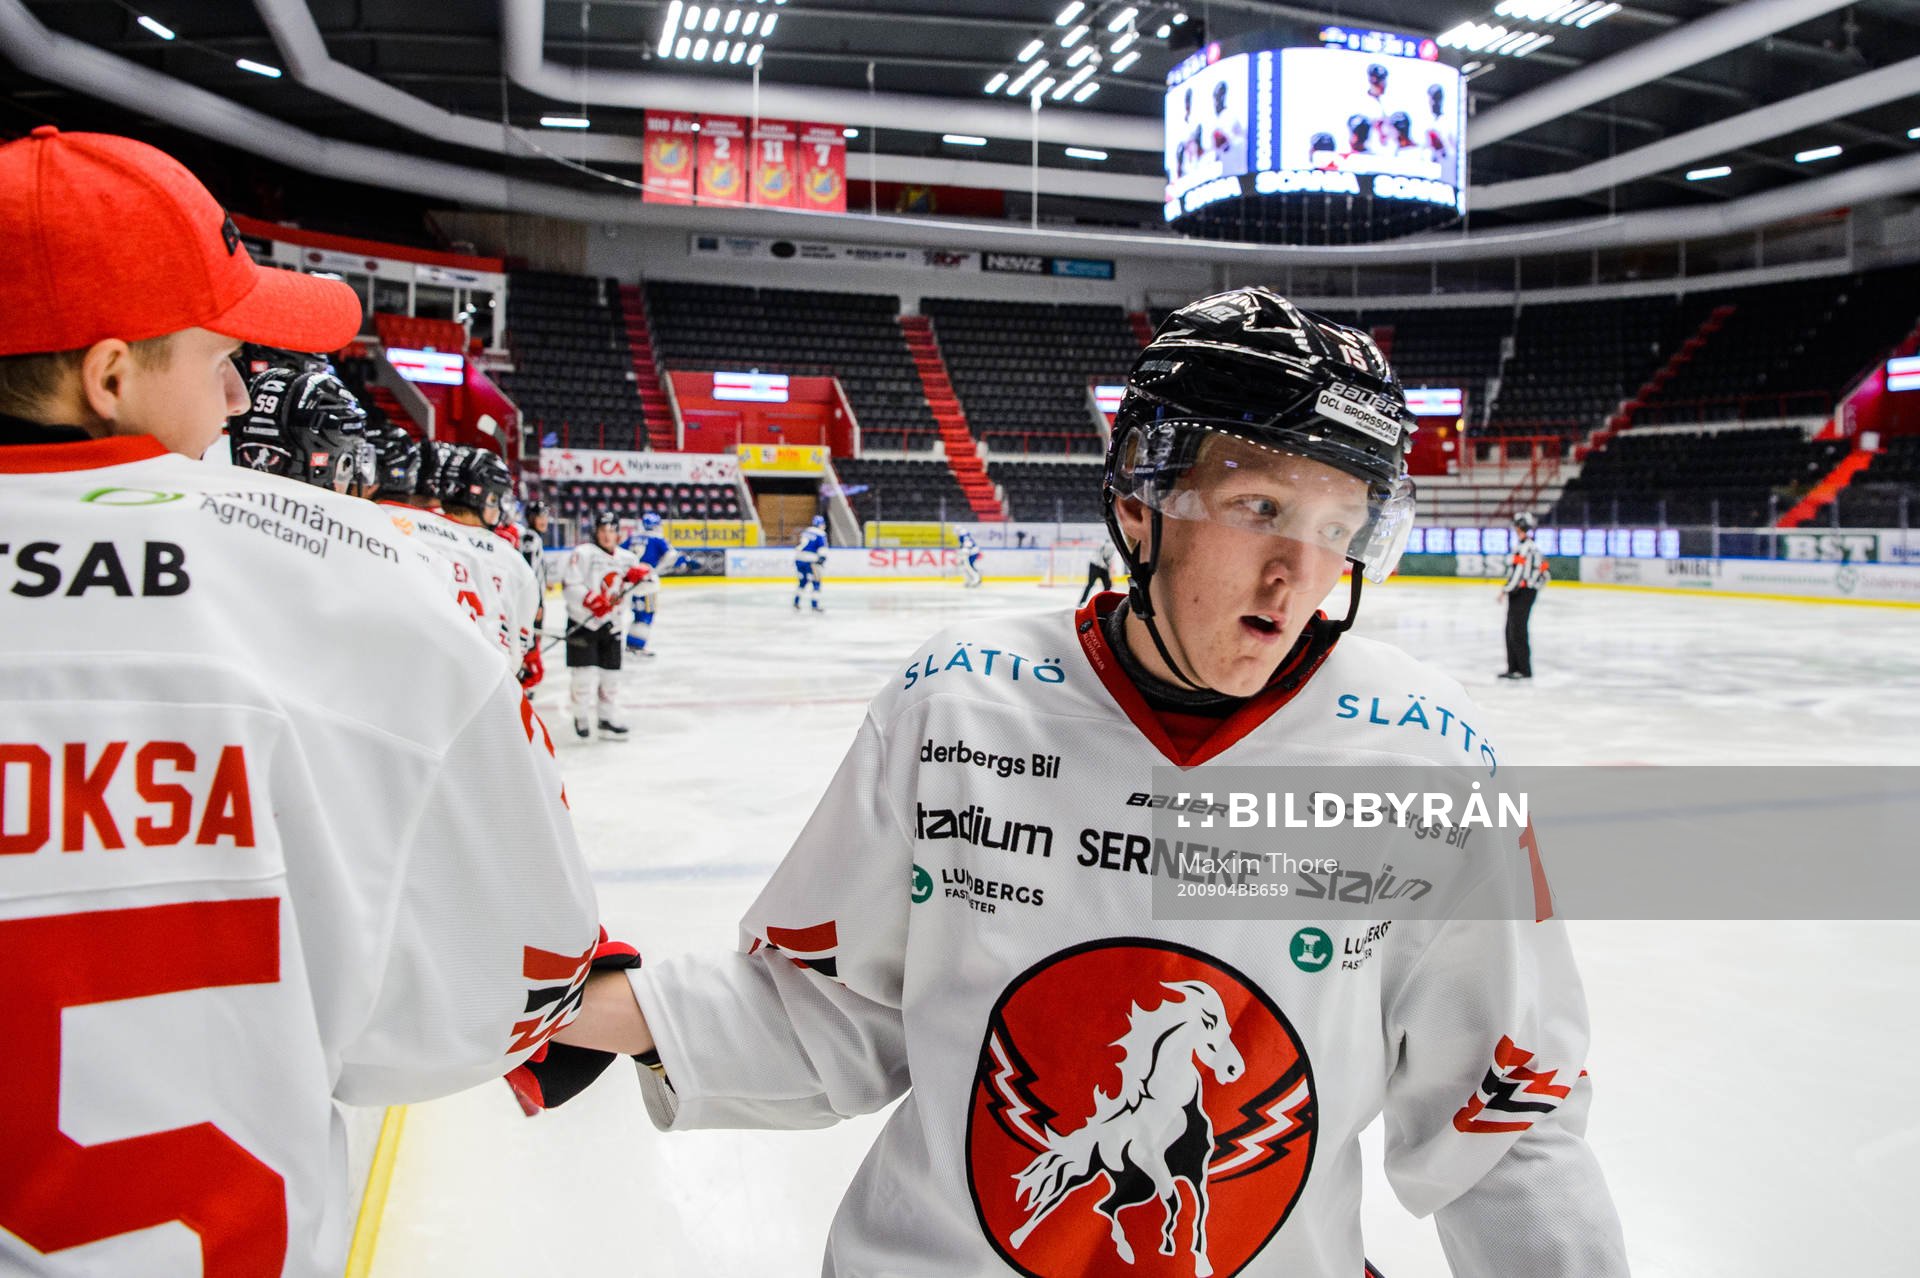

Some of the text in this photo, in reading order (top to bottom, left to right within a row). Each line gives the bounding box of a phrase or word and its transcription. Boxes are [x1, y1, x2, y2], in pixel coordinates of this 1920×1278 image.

[714, 137, 730, 159] 2
[763, 141, 784, 162] 11
[815, 144, 831, 166] 7
[253, 393, 279, 414] 59
[593, 458, 625, 475] ICA
[200, 494, 328, 559] Agroetanol
[202, 491, 400, 564] antmännen
[869, 550, 982, 567] SHAR
[1785, 535, 1875, 561] BST
[0, 541, 191, 598] SAB
[1456, 554, 1506, 576] BS
[904, 642, 1065, 689] SLÄTTÖ
[1335, 693, 1497, 778] SLÄTTÖ
[920, 738, 1061, 778] derbergs Bil
[914, 802, 1053, 858] tadium
[1077, 828, 1263, 893] SERNEKE
